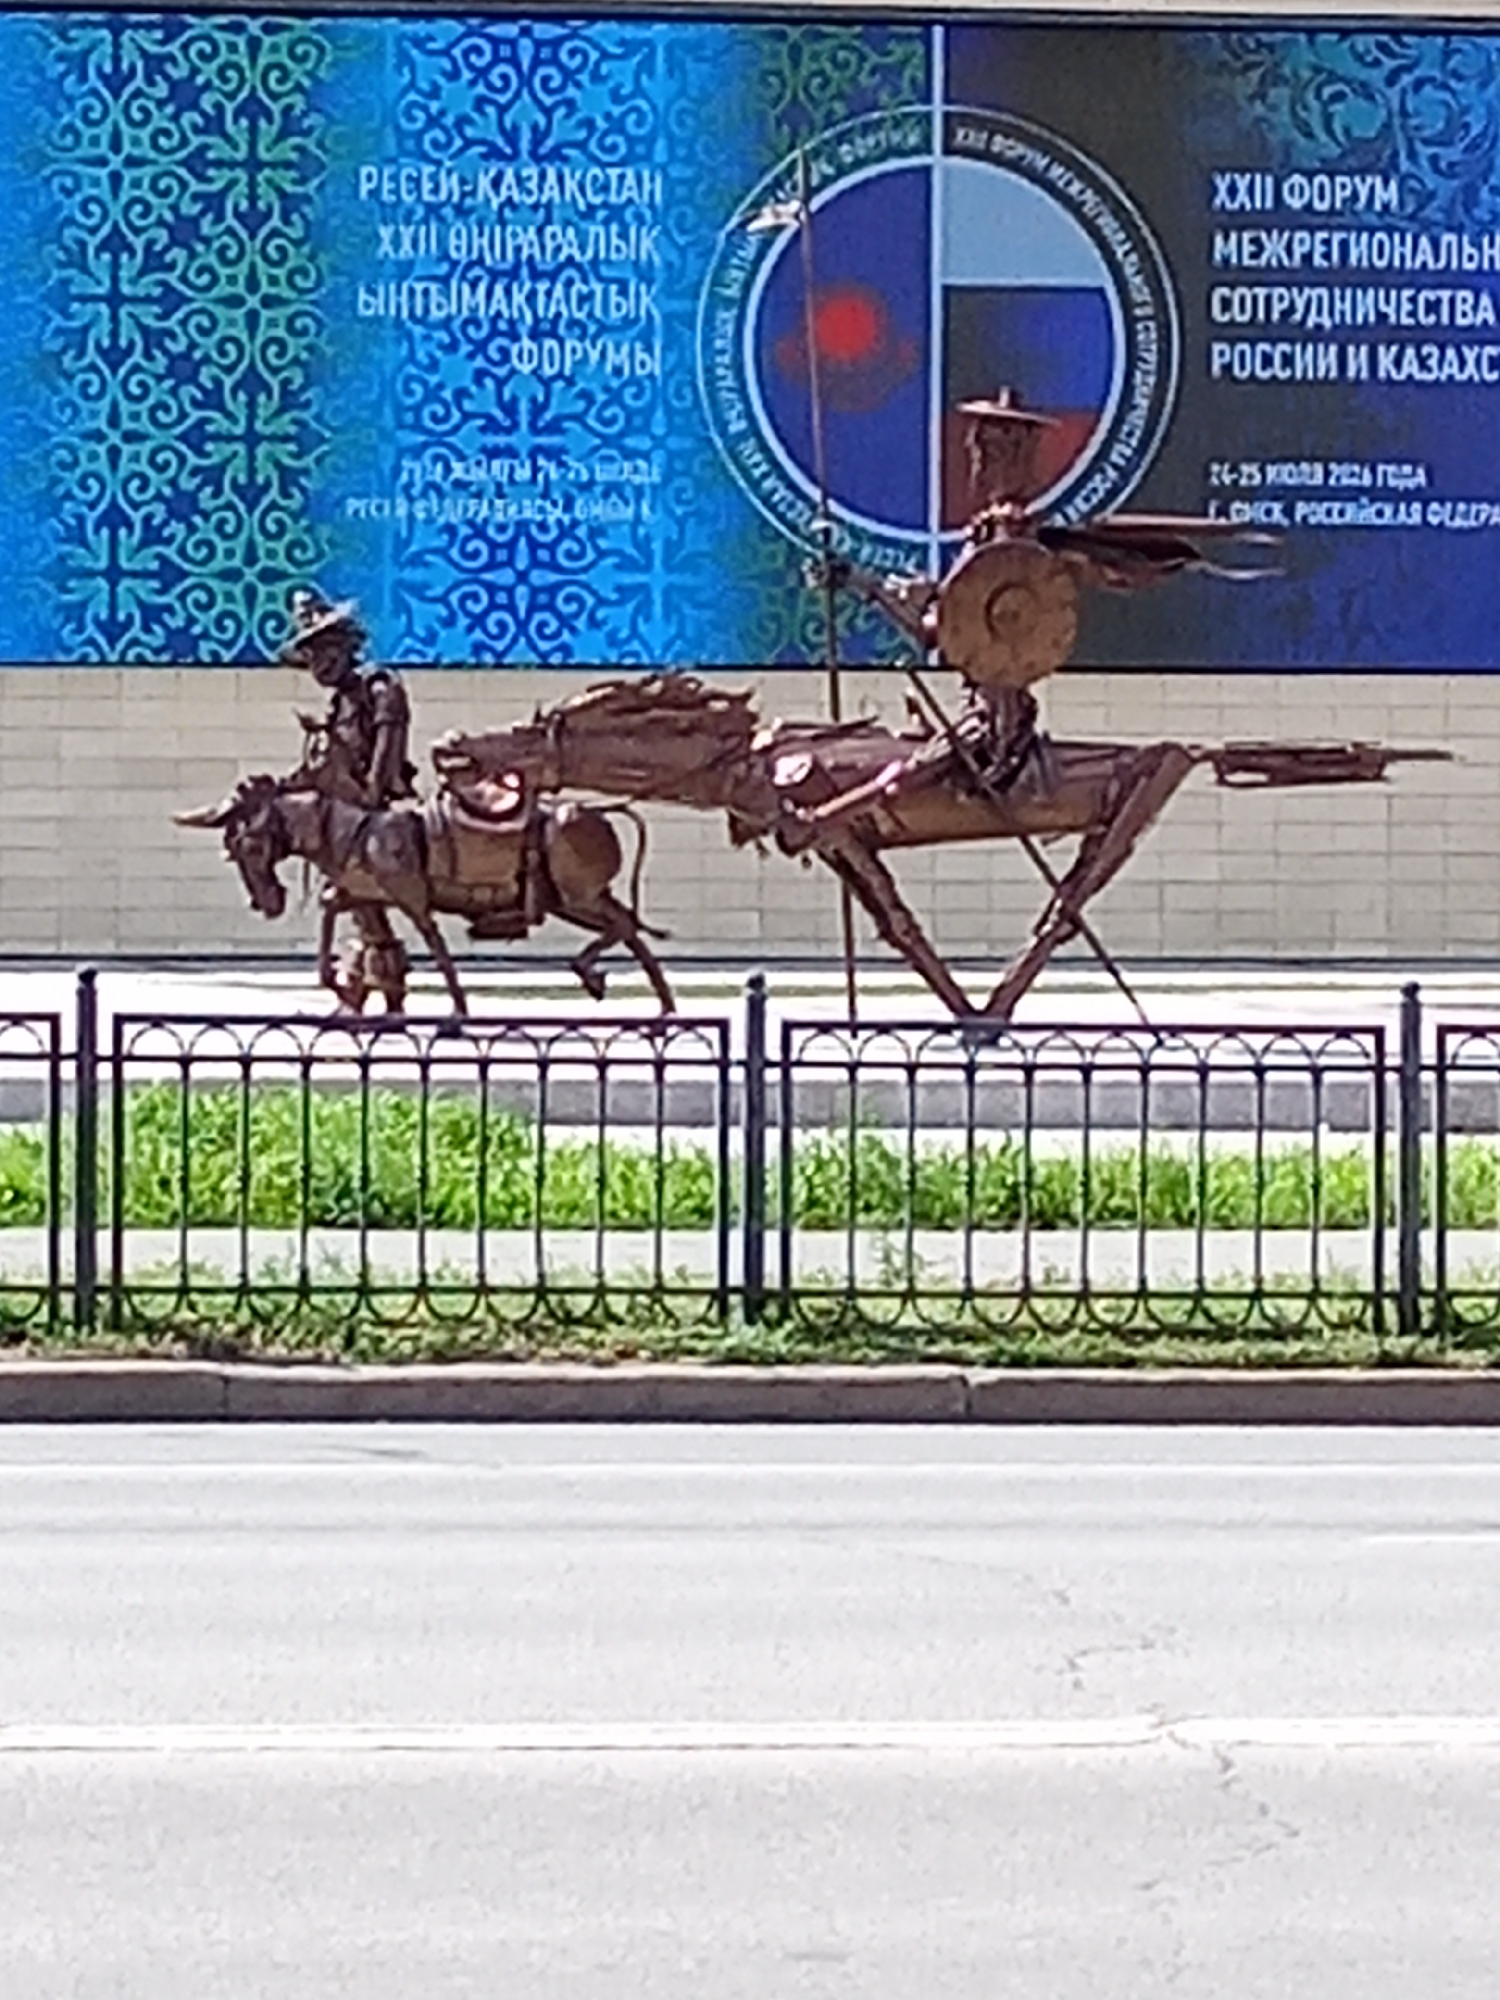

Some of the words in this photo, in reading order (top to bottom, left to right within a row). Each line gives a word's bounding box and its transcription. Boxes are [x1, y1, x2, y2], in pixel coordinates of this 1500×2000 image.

[359, 163, 663, 211] РЕСЕЙ-ҚАЗАҚСТАН
[1212, 172, 1275, 211] XXII
[1282, 173, 1399, 211] ФОРУМ
[378, 223, 438, 260] XXII
[1212, 229, 1500, 270] МЕЖРЕГИОНАЛЬН
[1211, 286, 1496, 330] СОТРУДНИЧЕСТВА
[511, 340, 661, 377] ФОРУМЫ
[1211, 342, 1338, 380] РОССИИ
[1347, 345, 1368, 380] И
[1378, 345, 1500, 381] КАЗАХС
